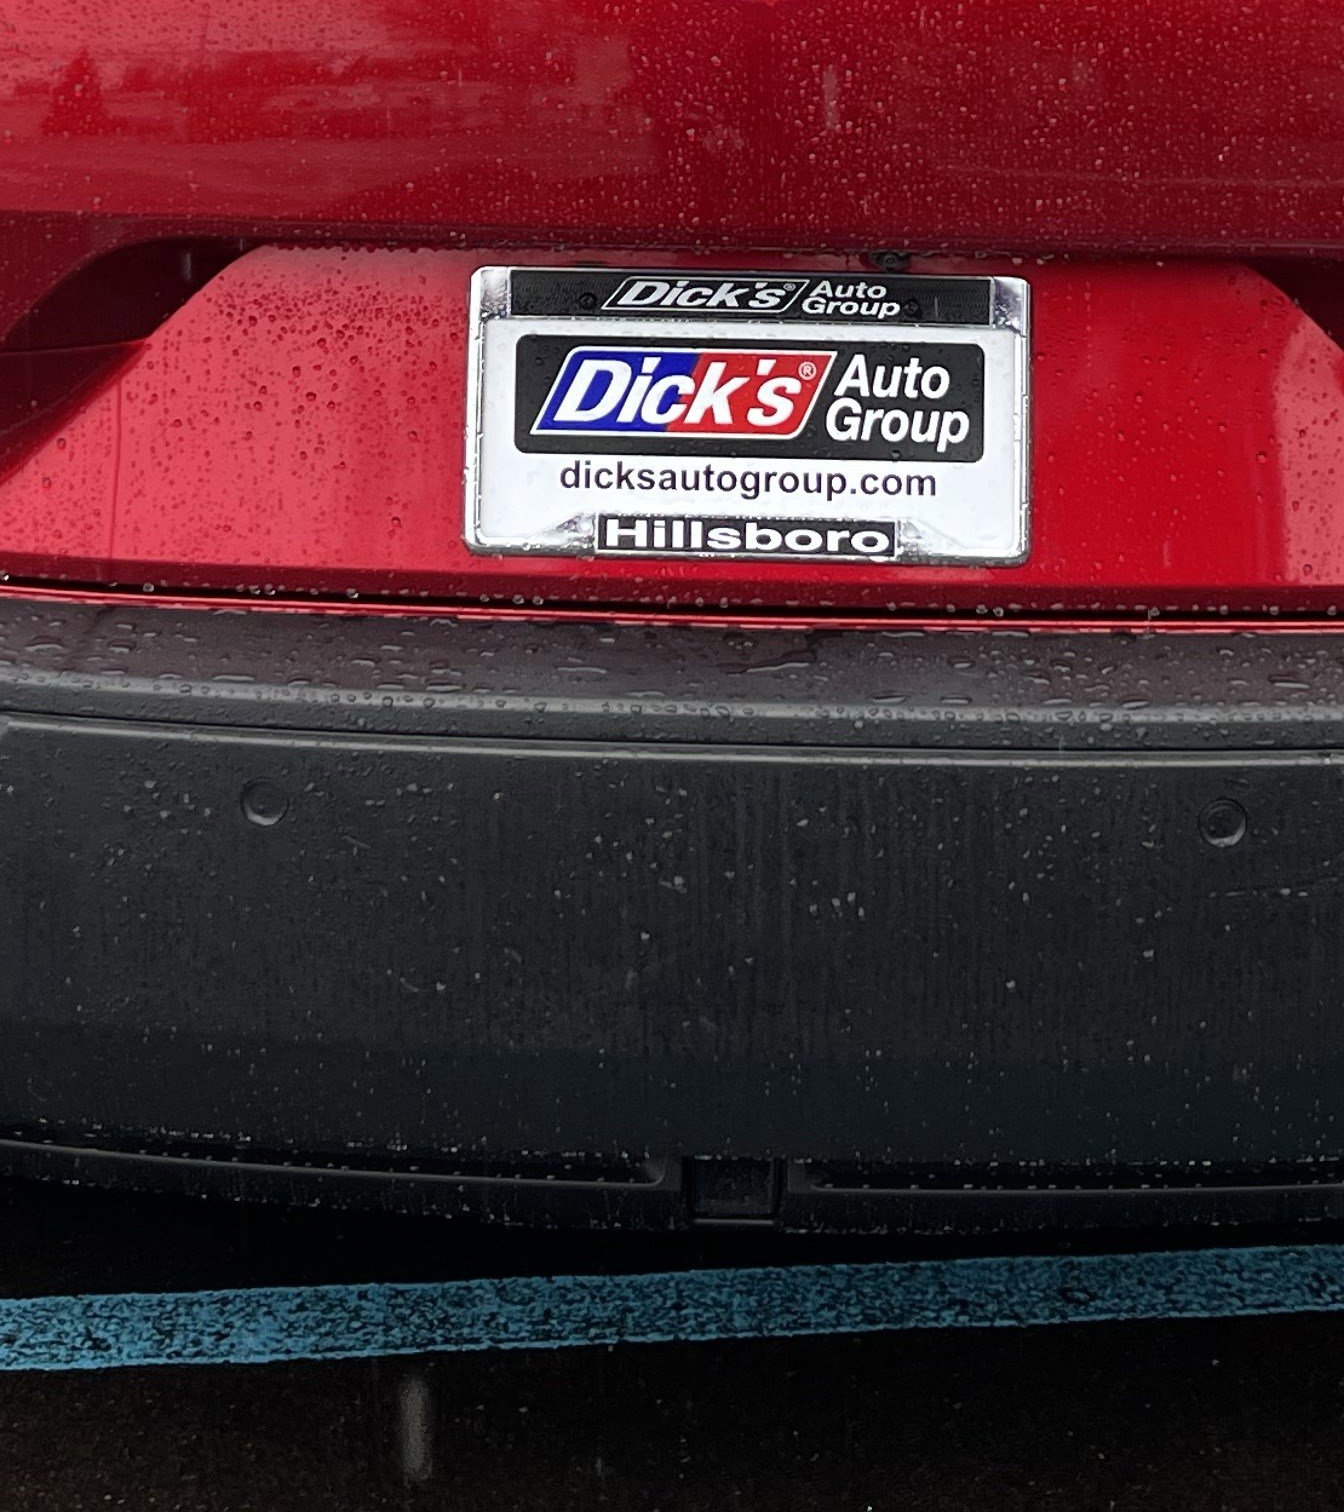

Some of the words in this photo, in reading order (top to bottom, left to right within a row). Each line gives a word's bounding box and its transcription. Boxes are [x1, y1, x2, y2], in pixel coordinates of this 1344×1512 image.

[802, 296, 901, 319] Group
[809, 280, 888, 299] Auto
[833, 353, 951, 400] Auto
[825, 398, 970, 453] Group
[560, 460, 937, 501] dicksautogroup.com
[605, 518, 892, 555] Hillsboro
